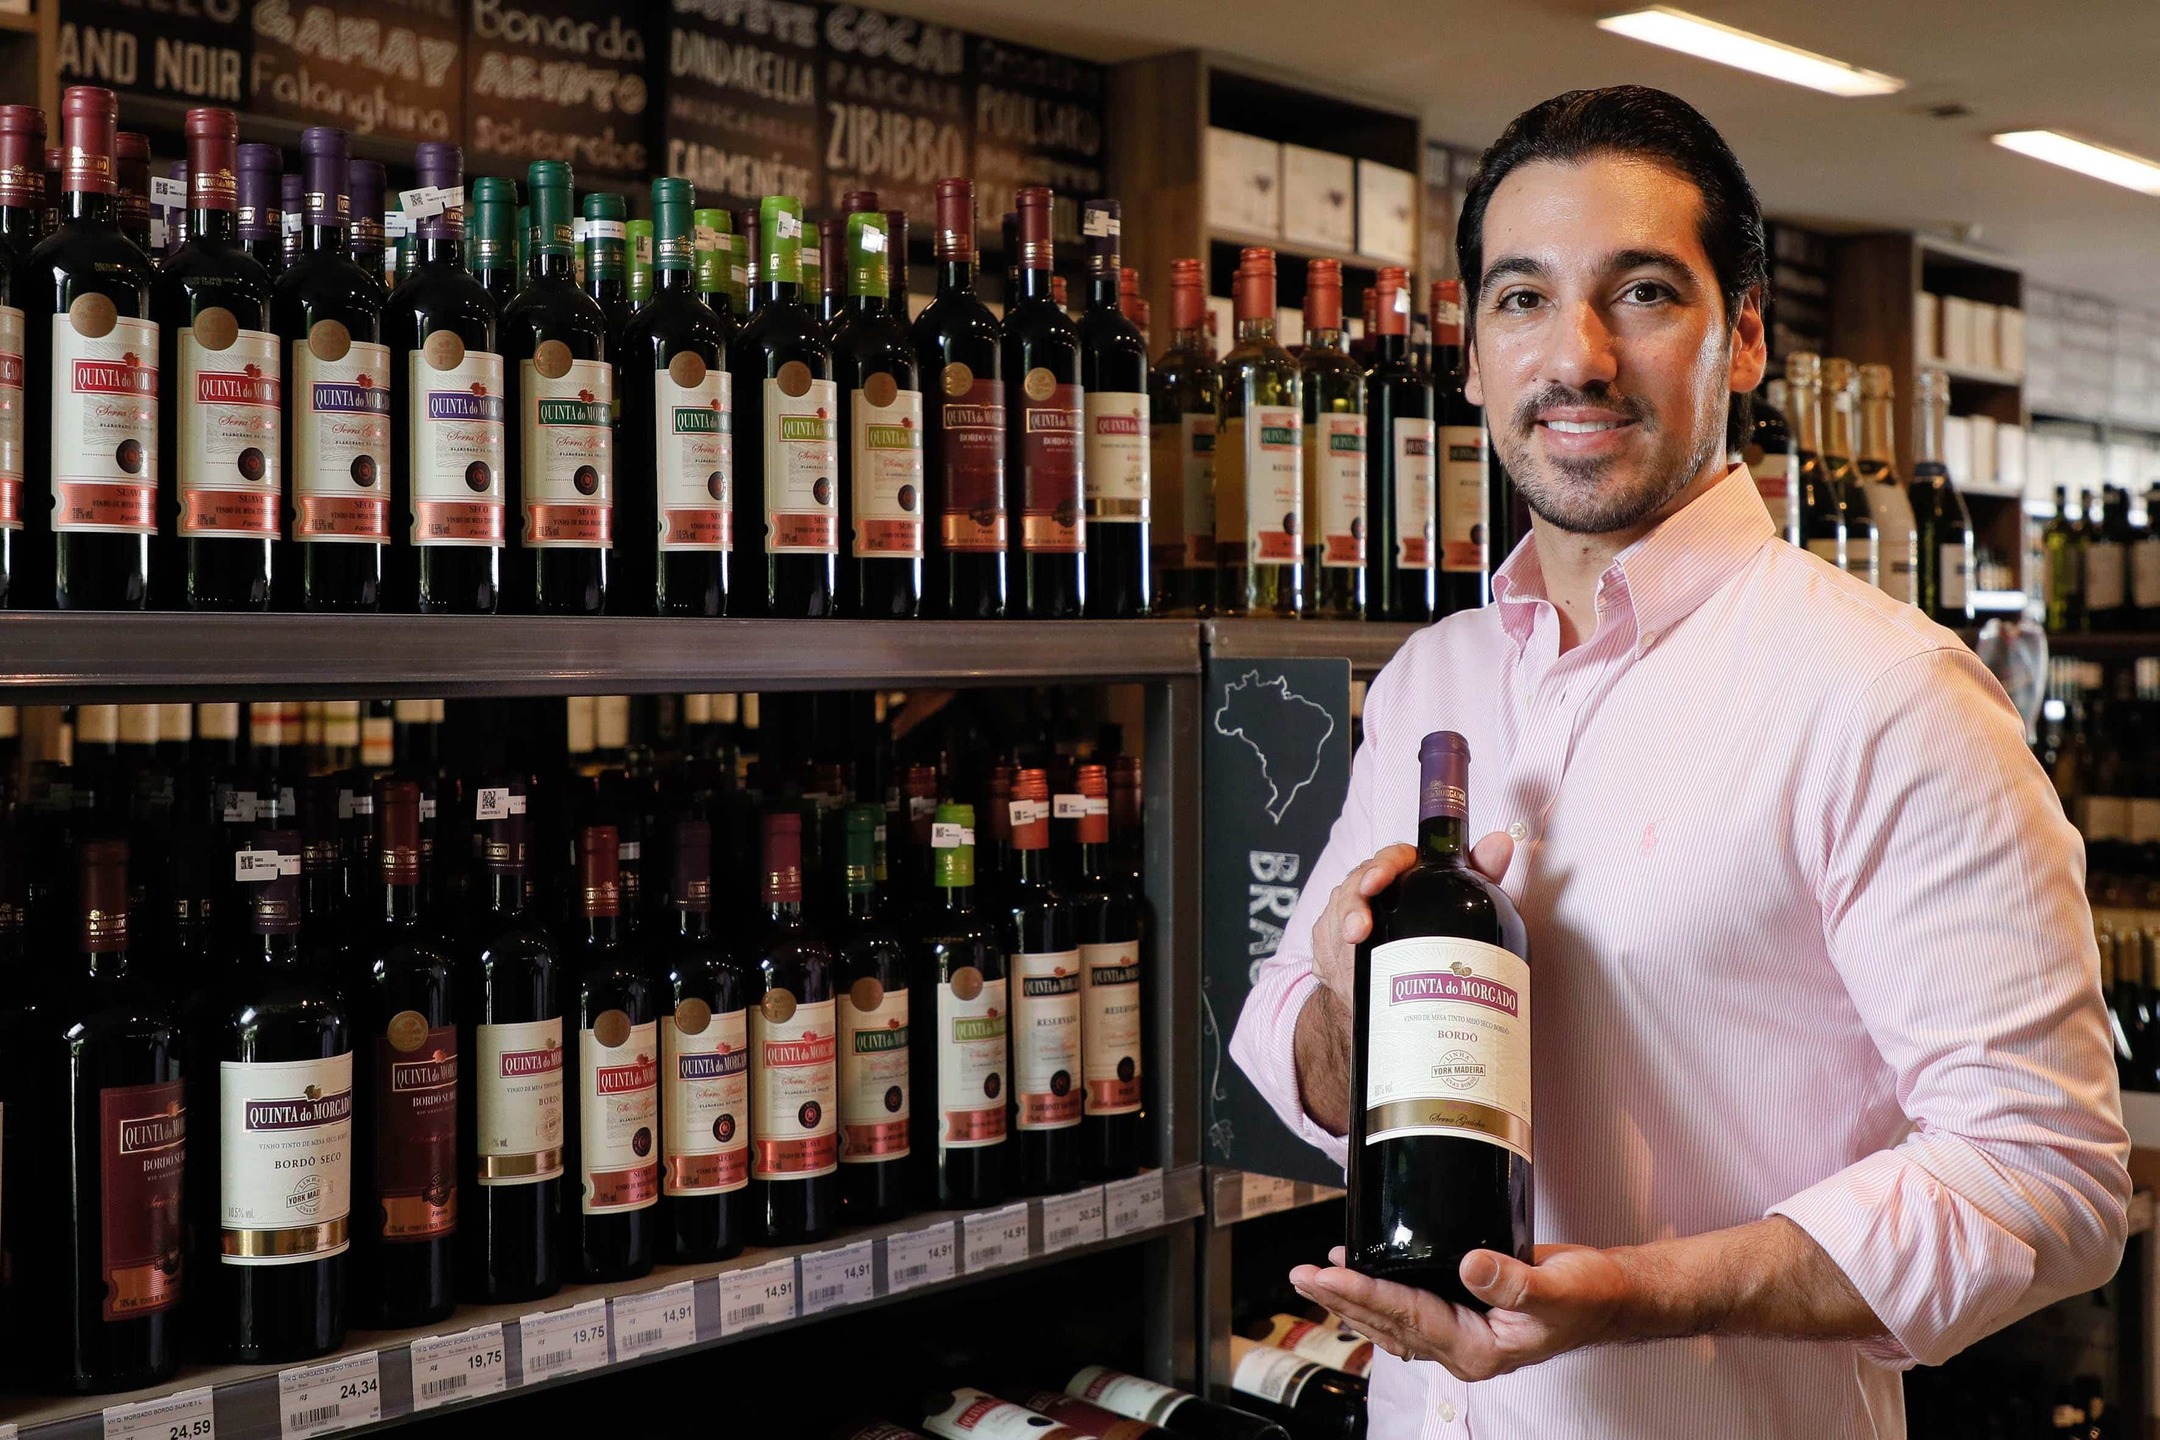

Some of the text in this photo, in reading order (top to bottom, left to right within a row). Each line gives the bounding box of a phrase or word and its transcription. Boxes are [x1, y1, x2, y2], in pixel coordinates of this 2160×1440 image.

[473, 0, 646, 62] Bonarda
[252, 0, 458, 88] GAMAY
[155, 36, 241, 100] NOIR
[250, 52, 449, 141] Falanghina
[826, 101, 965, 183] ZIBIBBO
[78, 367, 132, 389] QUINTA do
[201, 379, 253, 401] QUINTA do
[315, 388, 364, 409] QUINTA do
[96, 404, 127, 419] Serra
[431, 397, 478, 418] QUINTA do
[540, 405, 586, 423] QUINTA do
[218, 414, 249, 428] Serra
[677, 413, 710, 431] QUINTA
[946, 409, 976, 425] QUINTA
[1031, 413, 1060, 428] QUINTA
[1100, 418, 1130, 433] QUINTA
[332, 423, 360, 434] Serra
[446, 430, 475, 441] Serra
[784, 421, 815, 438] QUINTA
[870, 431, 899, 444] QUINTA
[469, 505, 489, 514] SECO
[1395, 978, 1517, 1011] QUINTA do MORGADO
[1404, 1014, 1422, 1022] VINHO
[1448, 1014, 1465, 1022] TINTO
[1466, 1017, 1480, 1026] MEIO
[857, 1033, 887, 1051] QUINTA
[1438, 1029, 1478, 1043] BORDÔ
[505, 1055, 550, 1074] QUINTA do
[768, 1047, 800, 1065] QUINTA
[1445, 1051, 1470, 1061] LINHA
[682, 1058, 723, 1078] QUINTA do
[1433, 1065, 1484, 1076] YORK MADEIRA
[397, 1068, 440, 1089] QUINTA do
[601, 1071, 633, 1091] QUINTA
[412, 1092, 441, 1107] BORDÔ
[249, 1106, 301, 1128] QUINTA
[301, 1108, 312, 1121] do
[1429, 1112, 1454, 1124] Serra
[125, 1123, 164, 1150] QUINTA
[143, 1152, 174, 1172] BORDÔ
[274, 1151, 341, 1169] BORDÔ SECO
[288, 1195, 306, 1205] YORK
[1078, 1207, 1101, 1222] 30,25
[1003, 1226, 1026, 1241] 14,91
[928, 1244, 952, 1260] 14,91
[844, 1264, 870, 1280] 14,91
[765, 1281, 793, 1299] 14,91
[663, 1305, 692, 1324] 14,91
[572, 1326, 605, 1344] 19,75
[468, 1350, 502, 1369] 19,75
[298, 1370, 325, 1379] MORGADO
[325, 1365, 343, 1374] BORDO
[340, 1378, 378, 1400] 24,34
[123, 1411, 153, 1421] MORGADO
[153, 1406, 174, 1415] BORDO
[174, 1400, 194, 1410] SUAVE
[169, 1419, 211, 1440] 24,59
